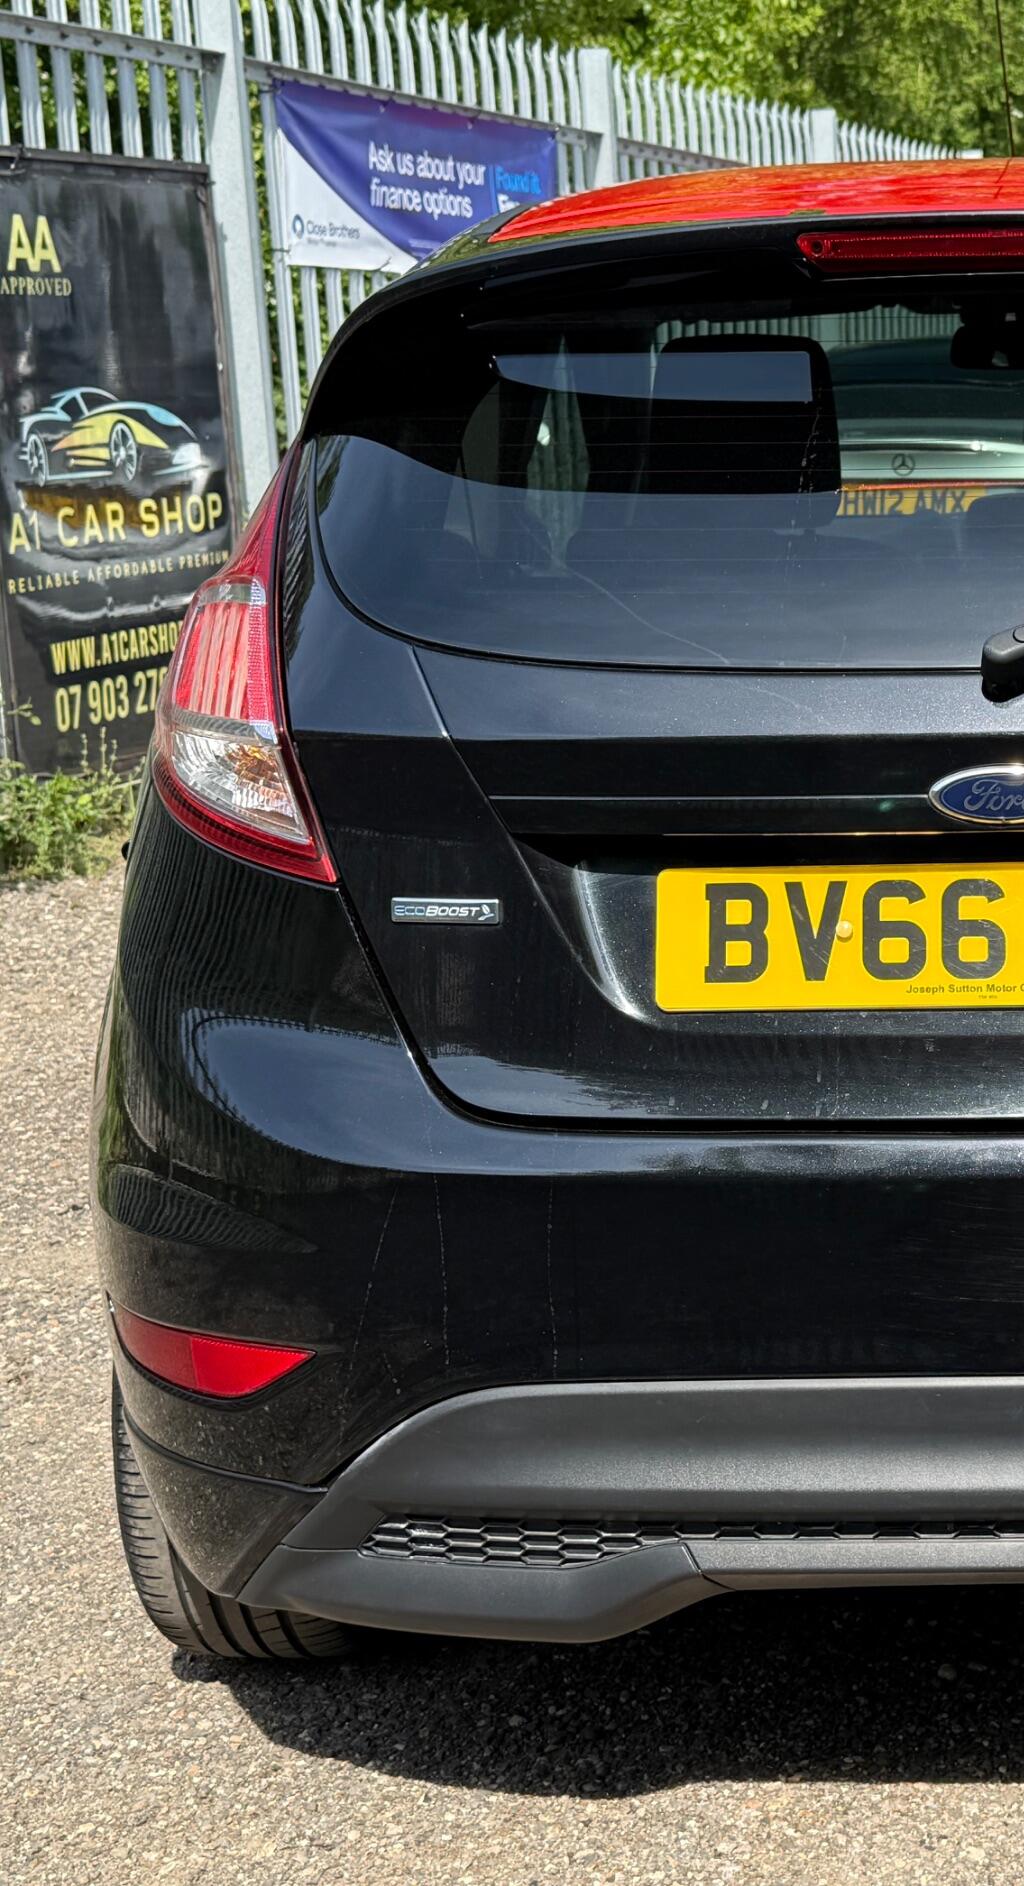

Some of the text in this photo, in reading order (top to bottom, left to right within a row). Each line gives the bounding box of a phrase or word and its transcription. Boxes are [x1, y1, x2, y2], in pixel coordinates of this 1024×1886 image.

[368, 141, 486, 189] Ask us about your
[370, 177, 422, 210] finance
[423, 187, 473, 220] options
[7, 213, 62, 273] AA
[0, 276, 72, 297] APPROVED
[8, 492, 222, 555] A1 CAR SHOP
[8, 551, 229, 595] RELIABLE AFFORDABLE PREMIUM
[55, 684, 82, 733] 07
[87, 674, 130, 725] 903
[704, 878, 1006, 983] BV66
[906, 984, 945, 995] Joseph
[947, 984, 983, 993] Sutton
[986, 983, 1017, 993] Motor
